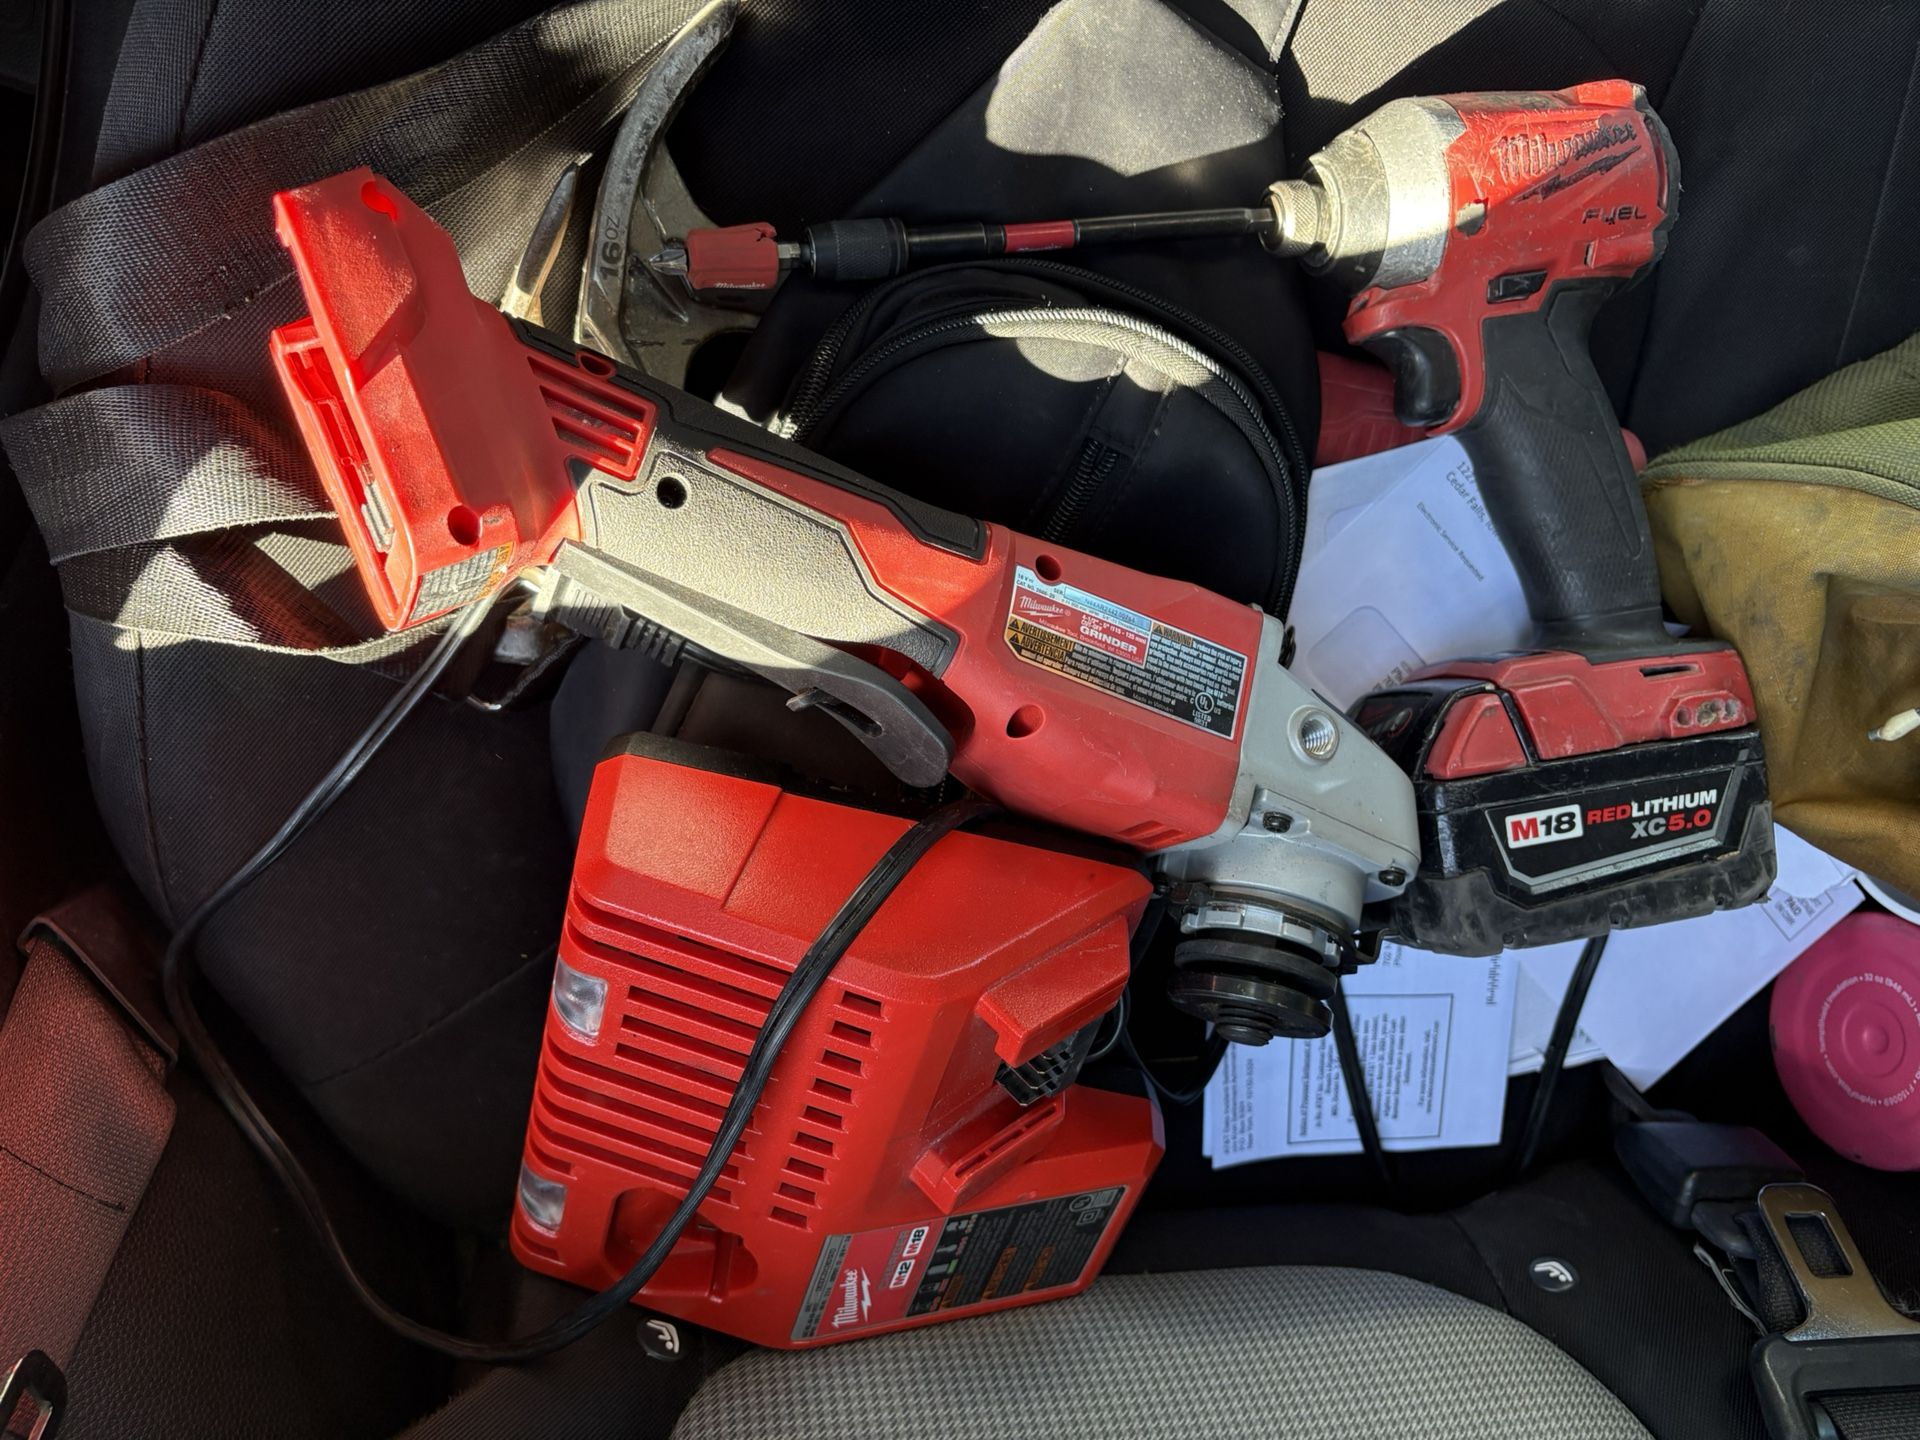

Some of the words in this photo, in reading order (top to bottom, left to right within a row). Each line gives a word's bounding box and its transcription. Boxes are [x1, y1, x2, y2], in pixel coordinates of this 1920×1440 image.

[1581, 207, 1648, 225] FUEL
[1446, 471, 1470, 499] Cedar
[1466, 496, 1486, 523] Falls,
[1018, 595, 1065, 615] Milwaukee
[1021, 621, 1071, 651] AVERTISSEMENT
[1021, 634, 1064, 663] ADVERTENCIA
[1079, 625, 1138, 655] GRINDER
[1192, 710, 1212, 722] LISTED
[1510, 811, 1576, 842] M18
[1586, 789, 1718, 825] REDLITHIUM
[1631, 809, 1712, 840] XC5.0
[906, 1228, 925, 1254] M18
[893, 1262, 912, 1287] M12
[831, 1268, 858, 1329] Milwaukee
